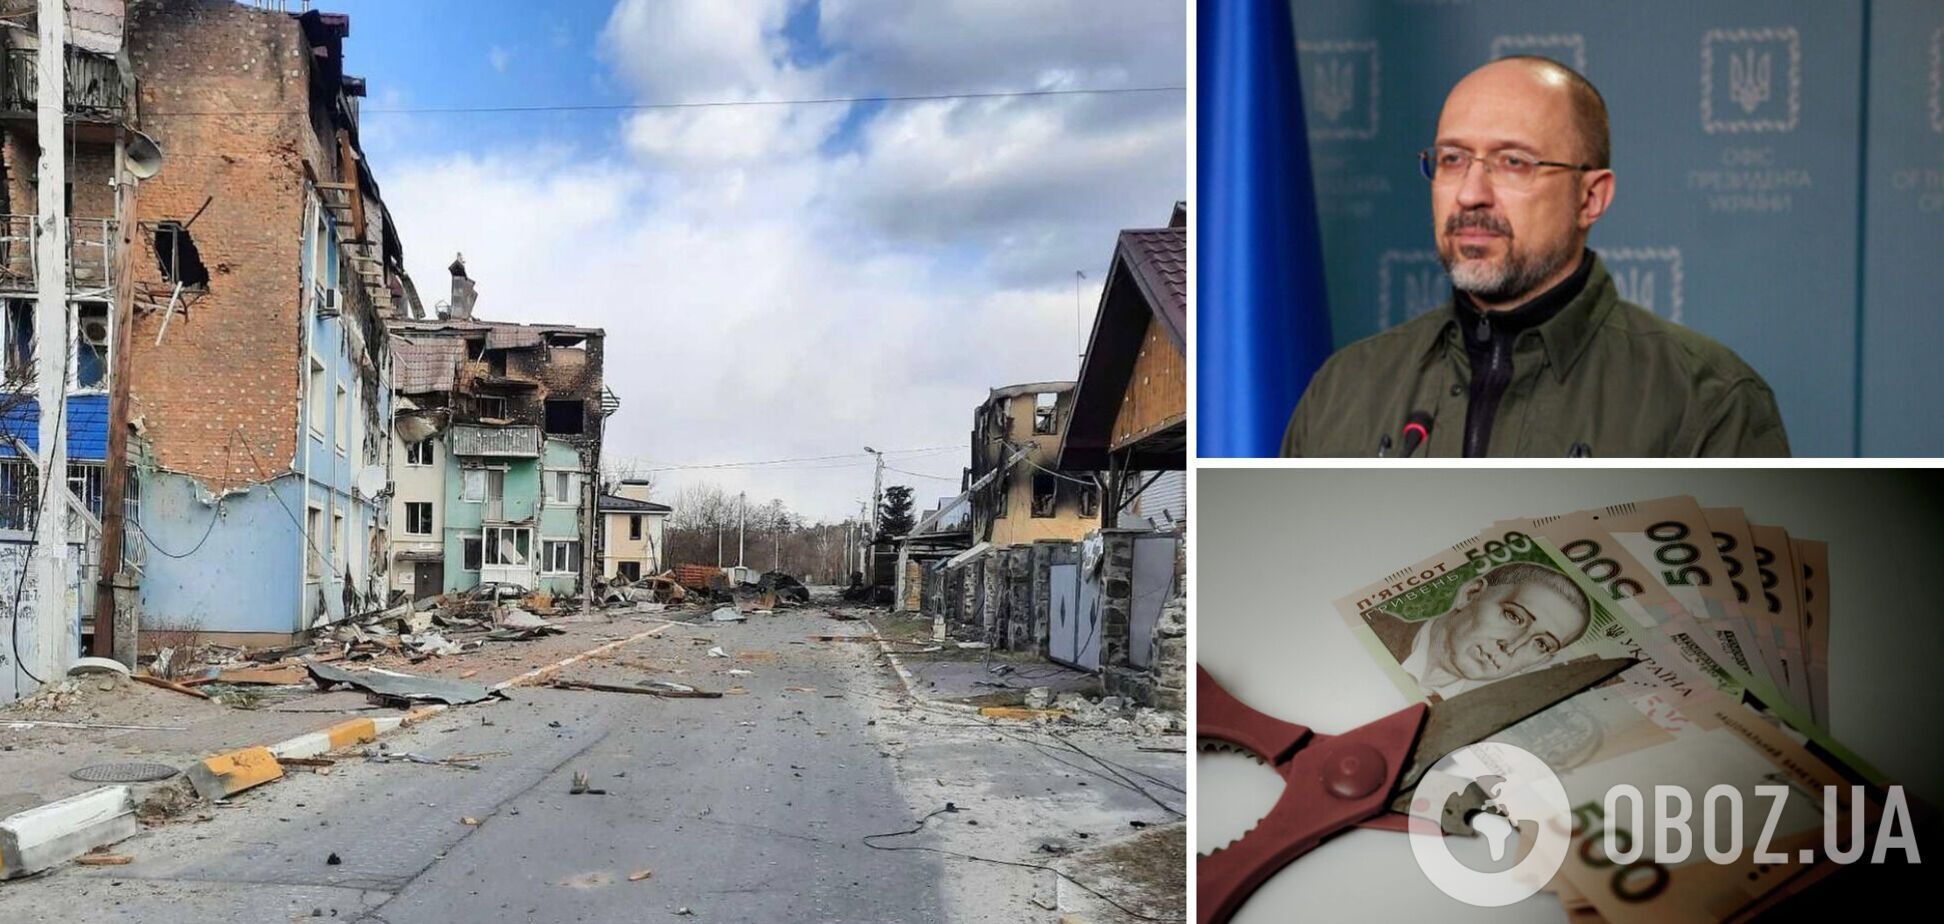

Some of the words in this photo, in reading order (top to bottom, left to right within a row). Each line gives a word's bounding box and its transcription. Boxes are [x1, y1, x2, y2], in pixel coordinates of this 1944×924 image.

[1463, 531, 1533, 575] 500
[1560, 538, 1645, 601] 500
[1644, 520, 1713, 587] 500
[1356, 561, 1447, 610] П'ЯТСОТ
[1365, 573, 1459, 620] ГРИВЕНЬ
[1620, 637, 1692, 697] УКРАЇНА
